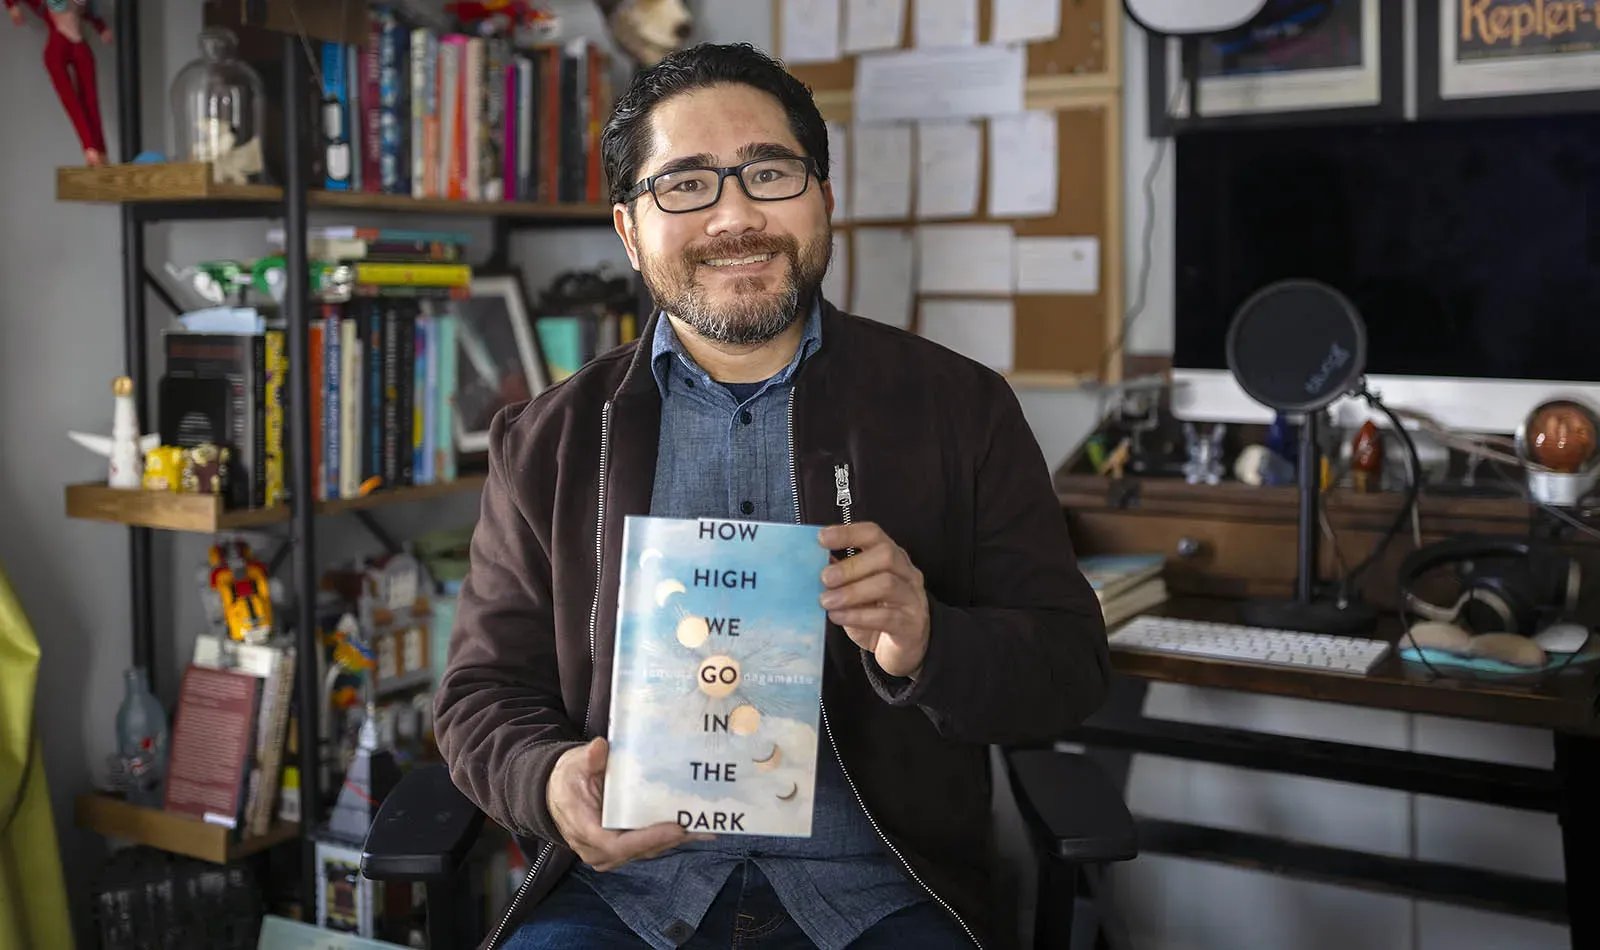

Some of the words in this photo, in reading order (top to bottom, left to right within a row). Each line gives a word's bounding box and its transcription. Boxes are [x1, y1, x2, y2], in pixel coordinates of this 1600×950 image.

[1461, 0, 1600, 47] Kepler-
[699, 521, 759, 542] HOW
[694, 568, 757, 590] HIGH
[705, 617, 741, 637] WE
[701, 665, 738, 685] GO
[704, 713, 730, 733] IN
[690, 761, 737, 783] THE
[676, 810, 745, 832] DARK
